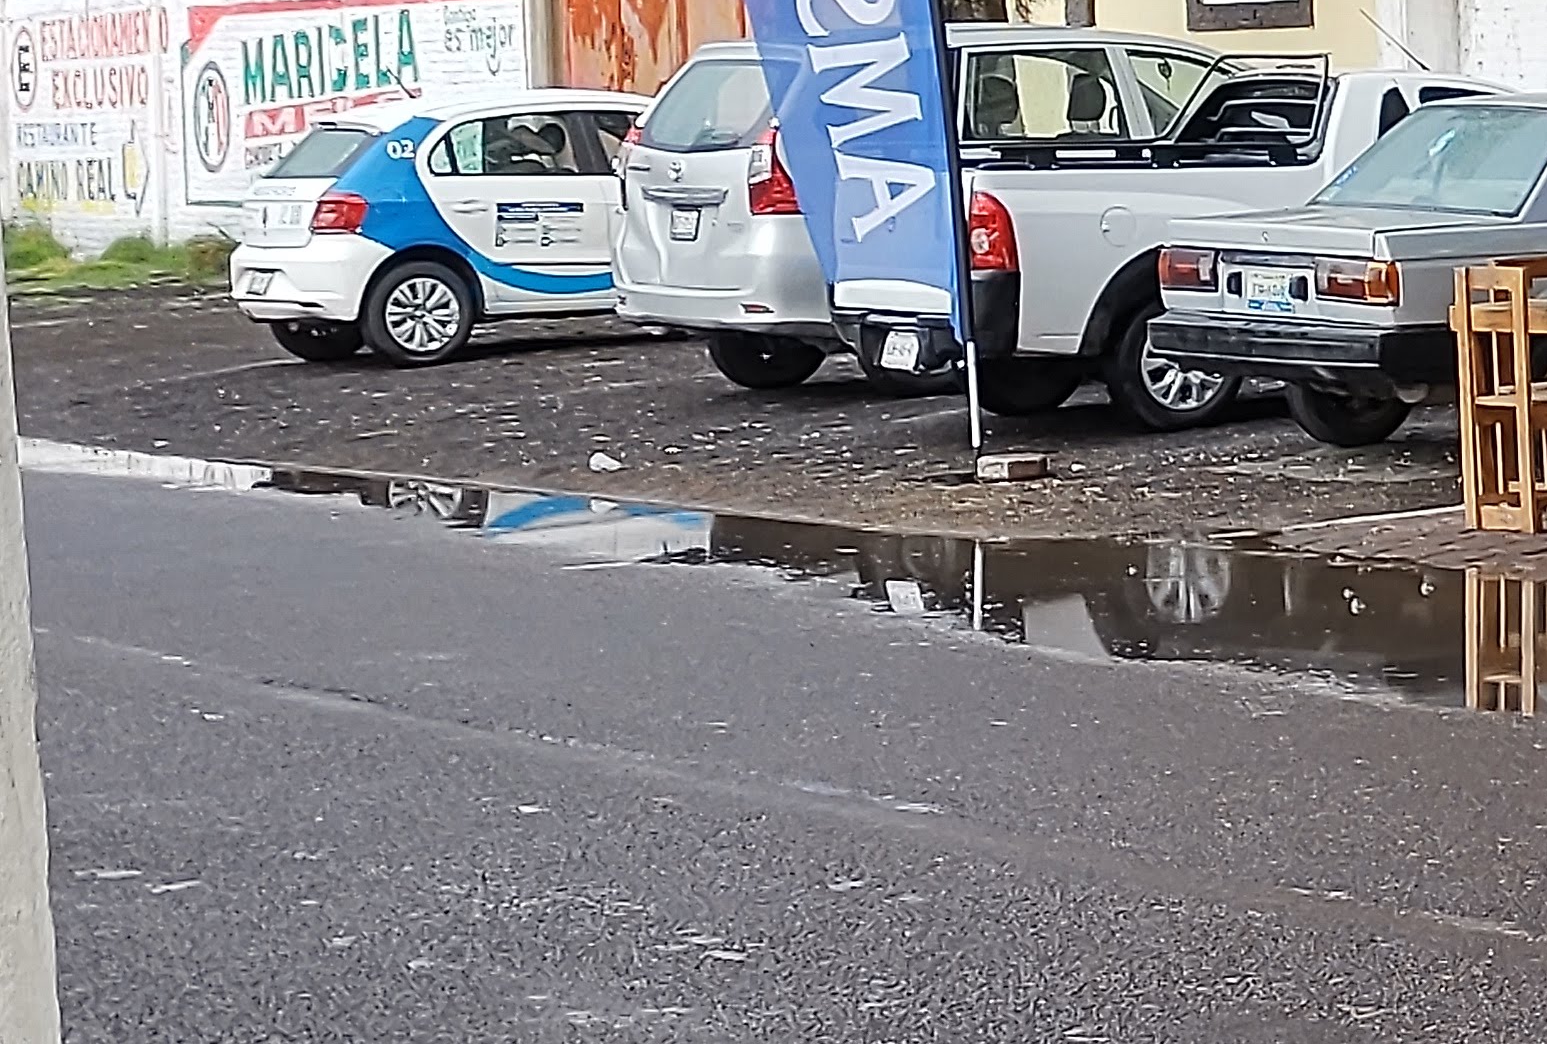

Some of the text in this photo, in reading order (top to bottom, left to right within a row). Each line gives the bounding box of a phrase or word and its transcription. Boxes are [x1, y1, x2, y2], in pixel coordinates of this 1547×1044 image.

[241, 9, 420, 105] MARICELA
[52, 64, 148, 109] EXCLUSIVO
[386, 139, 416, 160] 02
[76, 157, 116, 202] REAL
